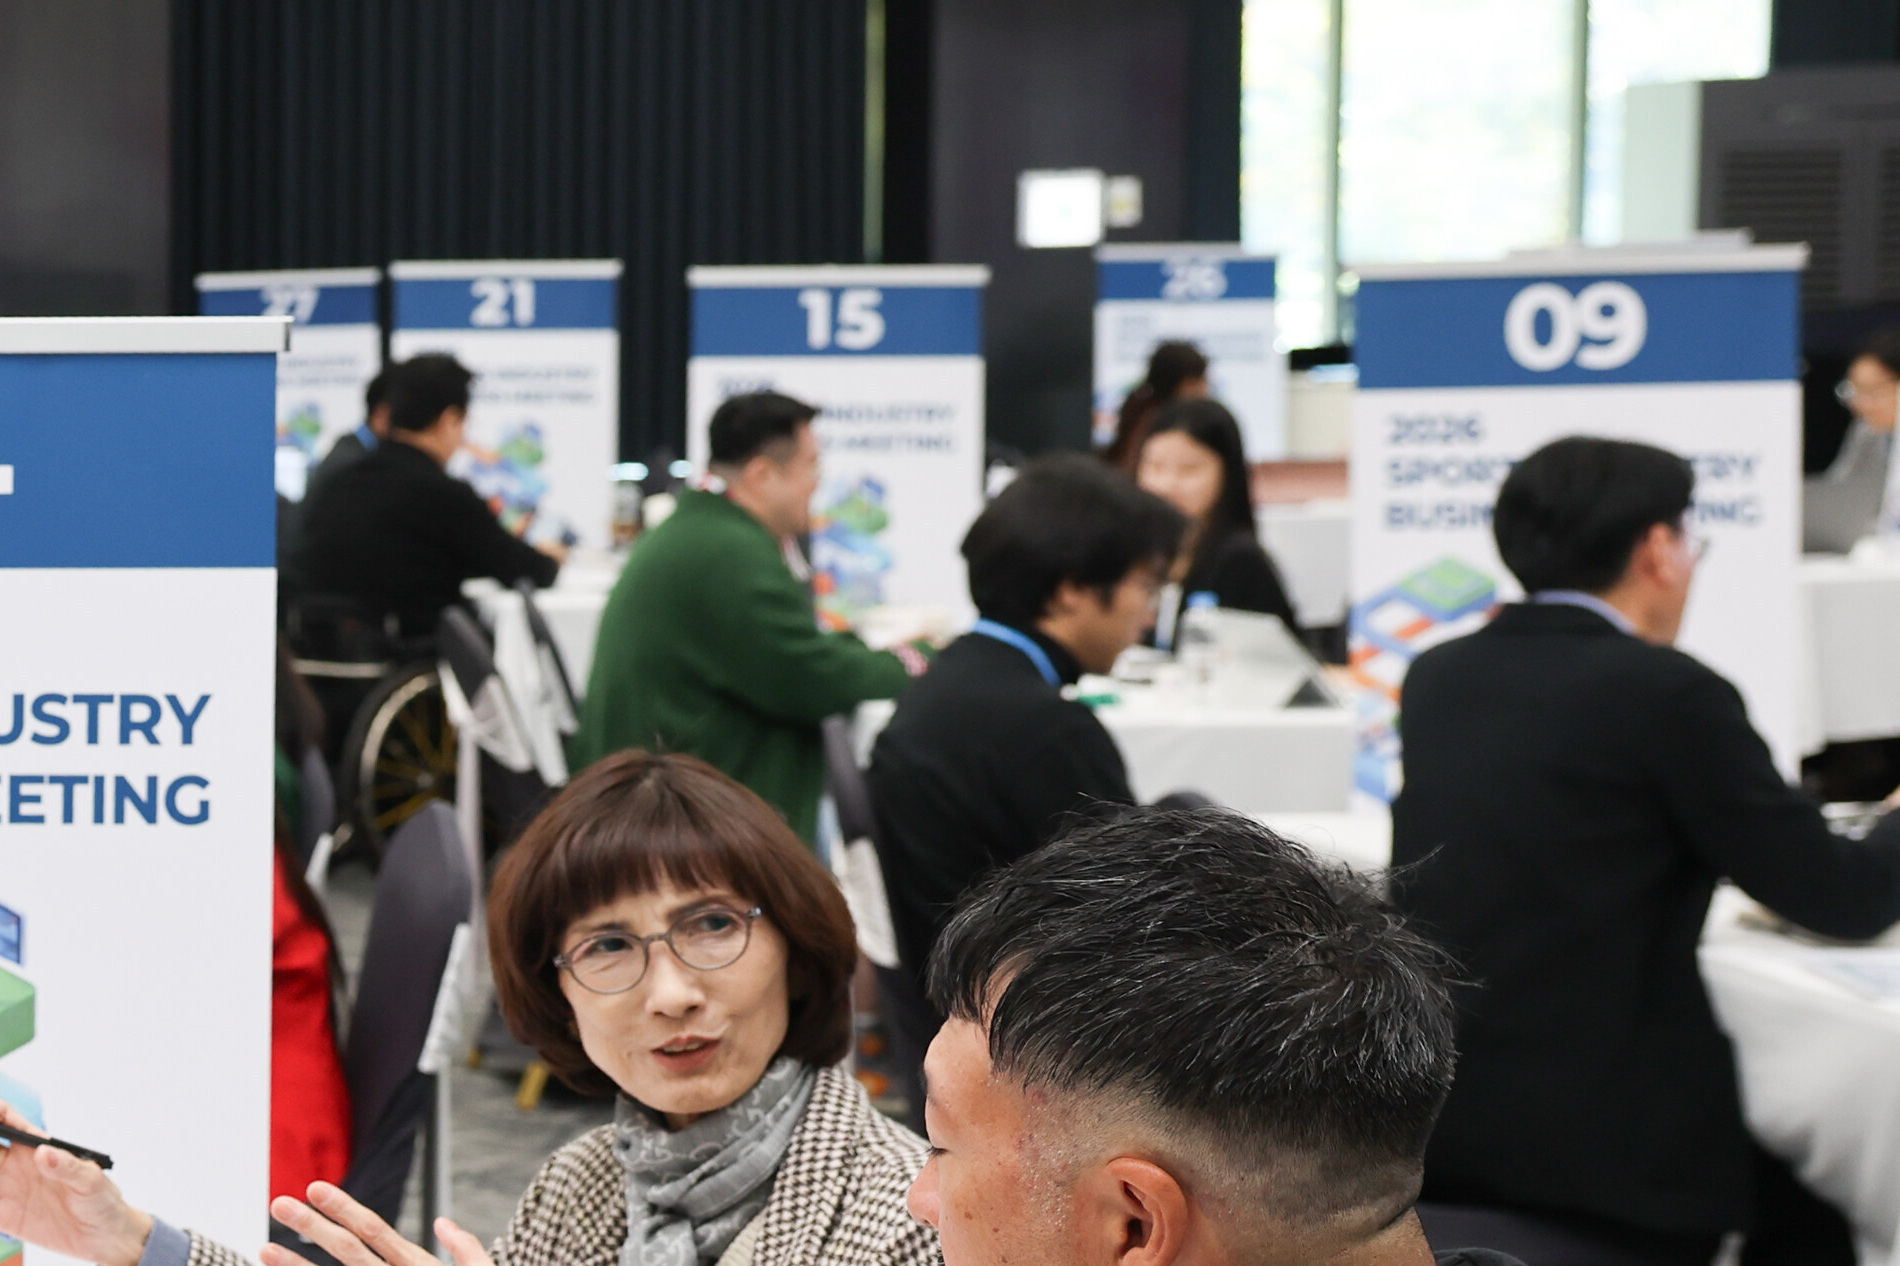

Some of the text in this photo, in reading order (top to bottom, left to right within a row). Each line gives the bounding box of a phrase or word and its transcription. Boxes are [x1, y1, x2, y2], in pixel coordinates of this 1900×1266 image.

[470, 279, 536, 328] 21
[798, 287, 886, 351] 15
[1504, 281, 1648, 372] 09
[1387, 499, 1496, 531] BUSIN
